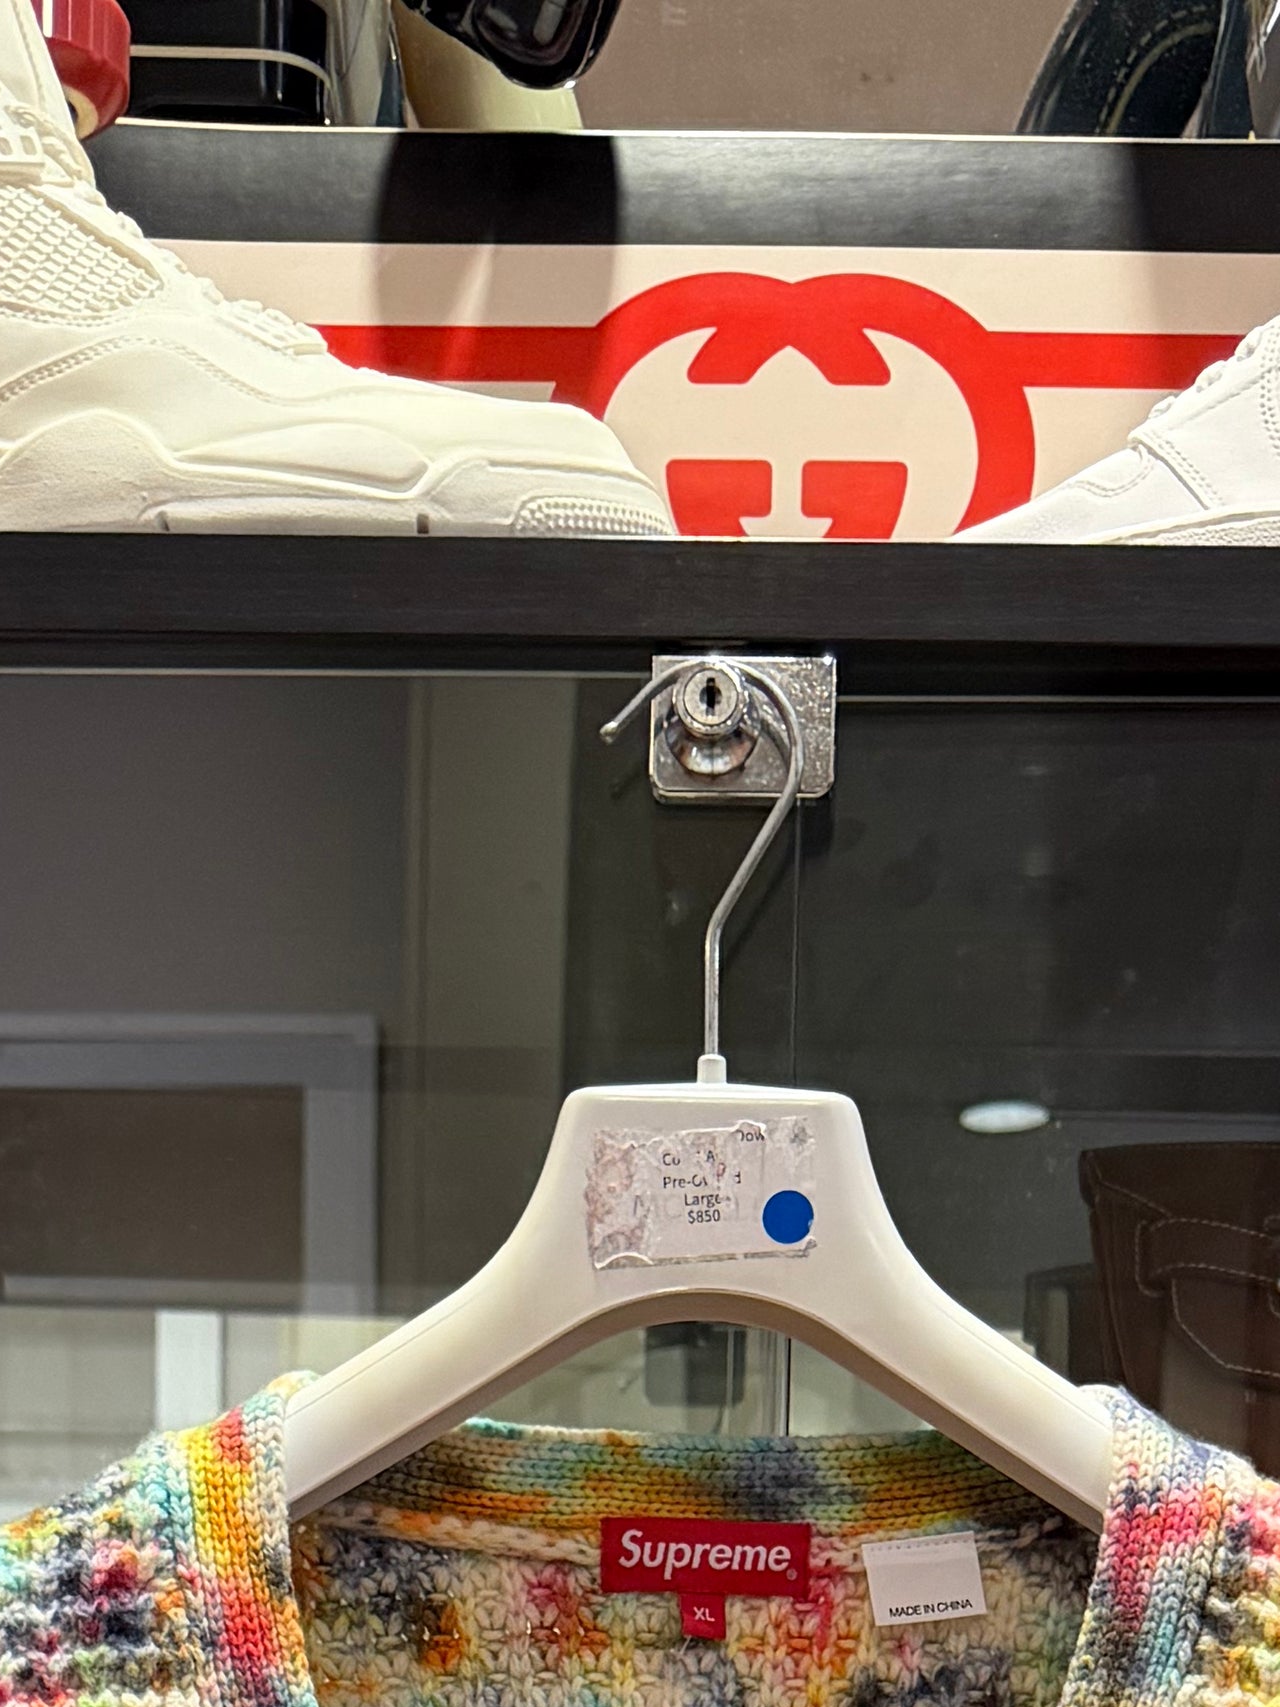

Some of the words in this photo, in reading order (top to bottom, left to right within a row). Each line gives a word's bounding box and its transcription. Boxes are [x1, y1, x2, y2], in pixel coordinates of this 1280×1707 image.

[687, 1209, 721, 1224] $850
[618, 1528, 792, 1581] Supreme
[693, 1606, 715, 1622] XL
[888, 1605, 922, 1617] MADE
[923, 1604, 936, 1614] IN
[936, 1599, 973, 1613] CHINA
